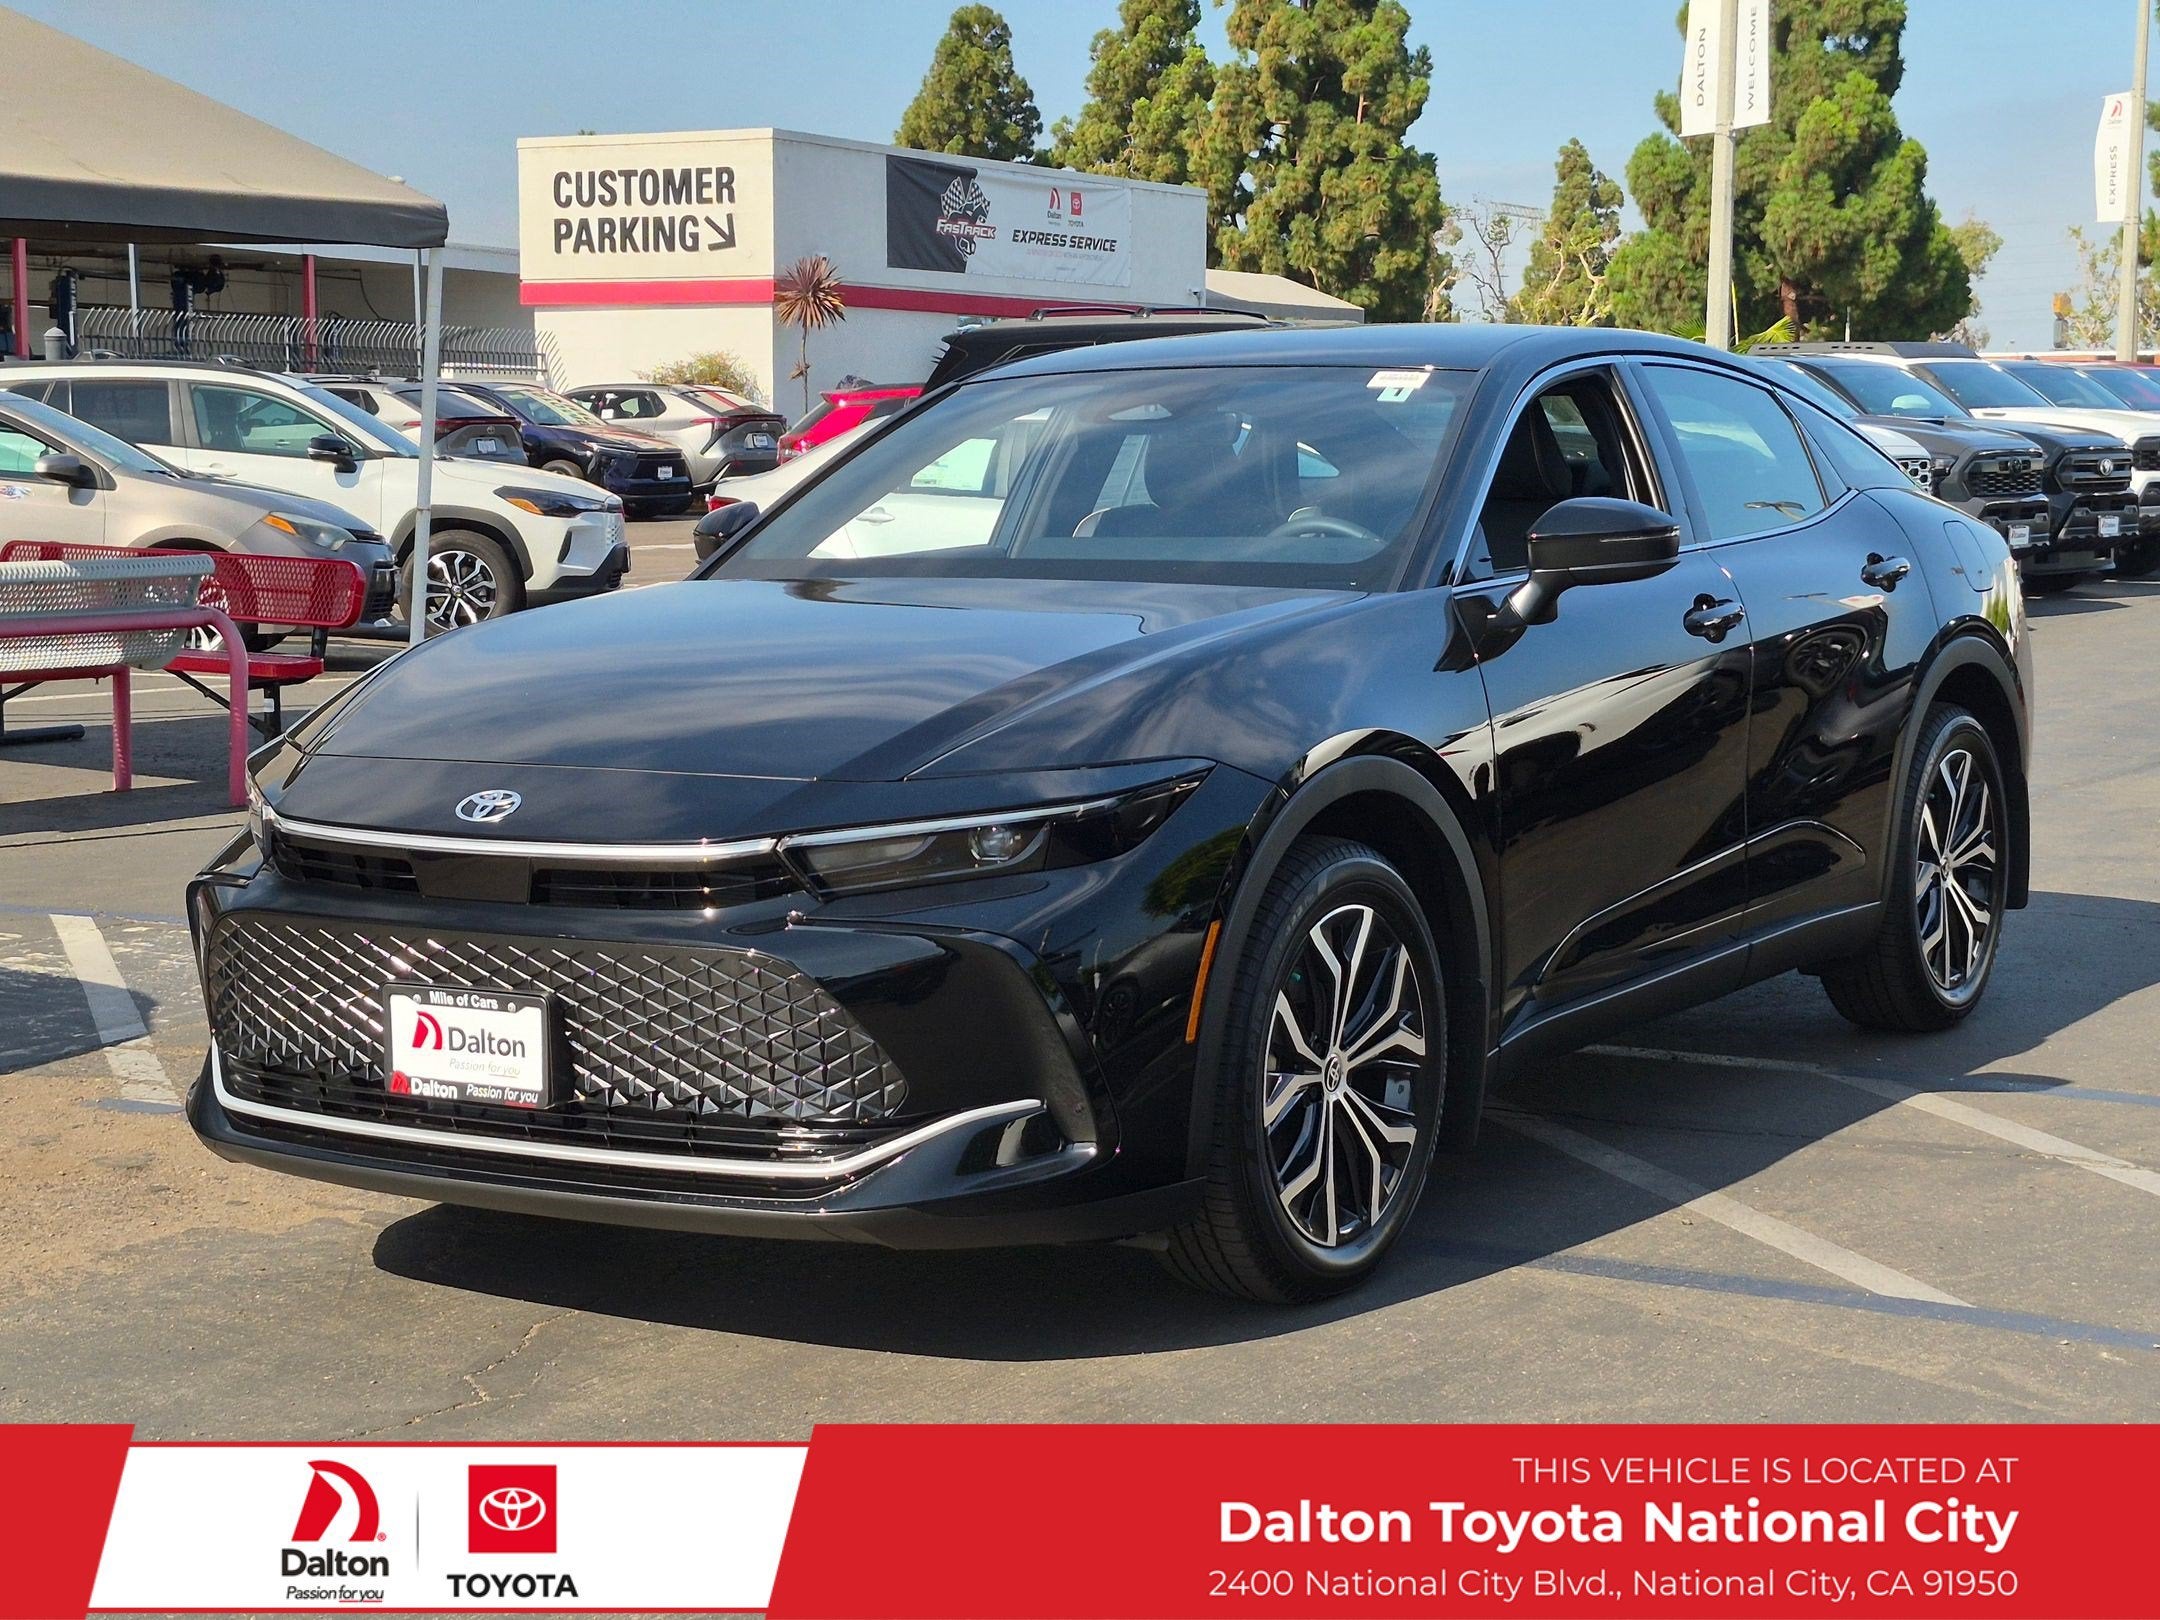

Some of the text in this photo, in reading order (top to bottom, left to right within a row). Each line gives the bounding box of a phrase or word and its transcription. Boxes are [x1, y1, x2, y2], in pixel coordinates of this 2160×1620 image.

[1696, 27, 1706, 107] DALTON
[1747, 6, 1757, 110] WELCOME
[553, 166, 736, 208] CUSTOMER
[2109, 145, 2118, 205] EXPRESS
[553, 214, 700, 254] PARKING
[1012, 229, 1117, 252] EXPRESS SERVICE
[429, 990, 498, 1009] Mile of Cars
[448, 1026, 526, 1058] Dalton
[449, 1057, 521, 1077] Passion for you
[410, 1077, 539, 1105] Dalton Passion for you
